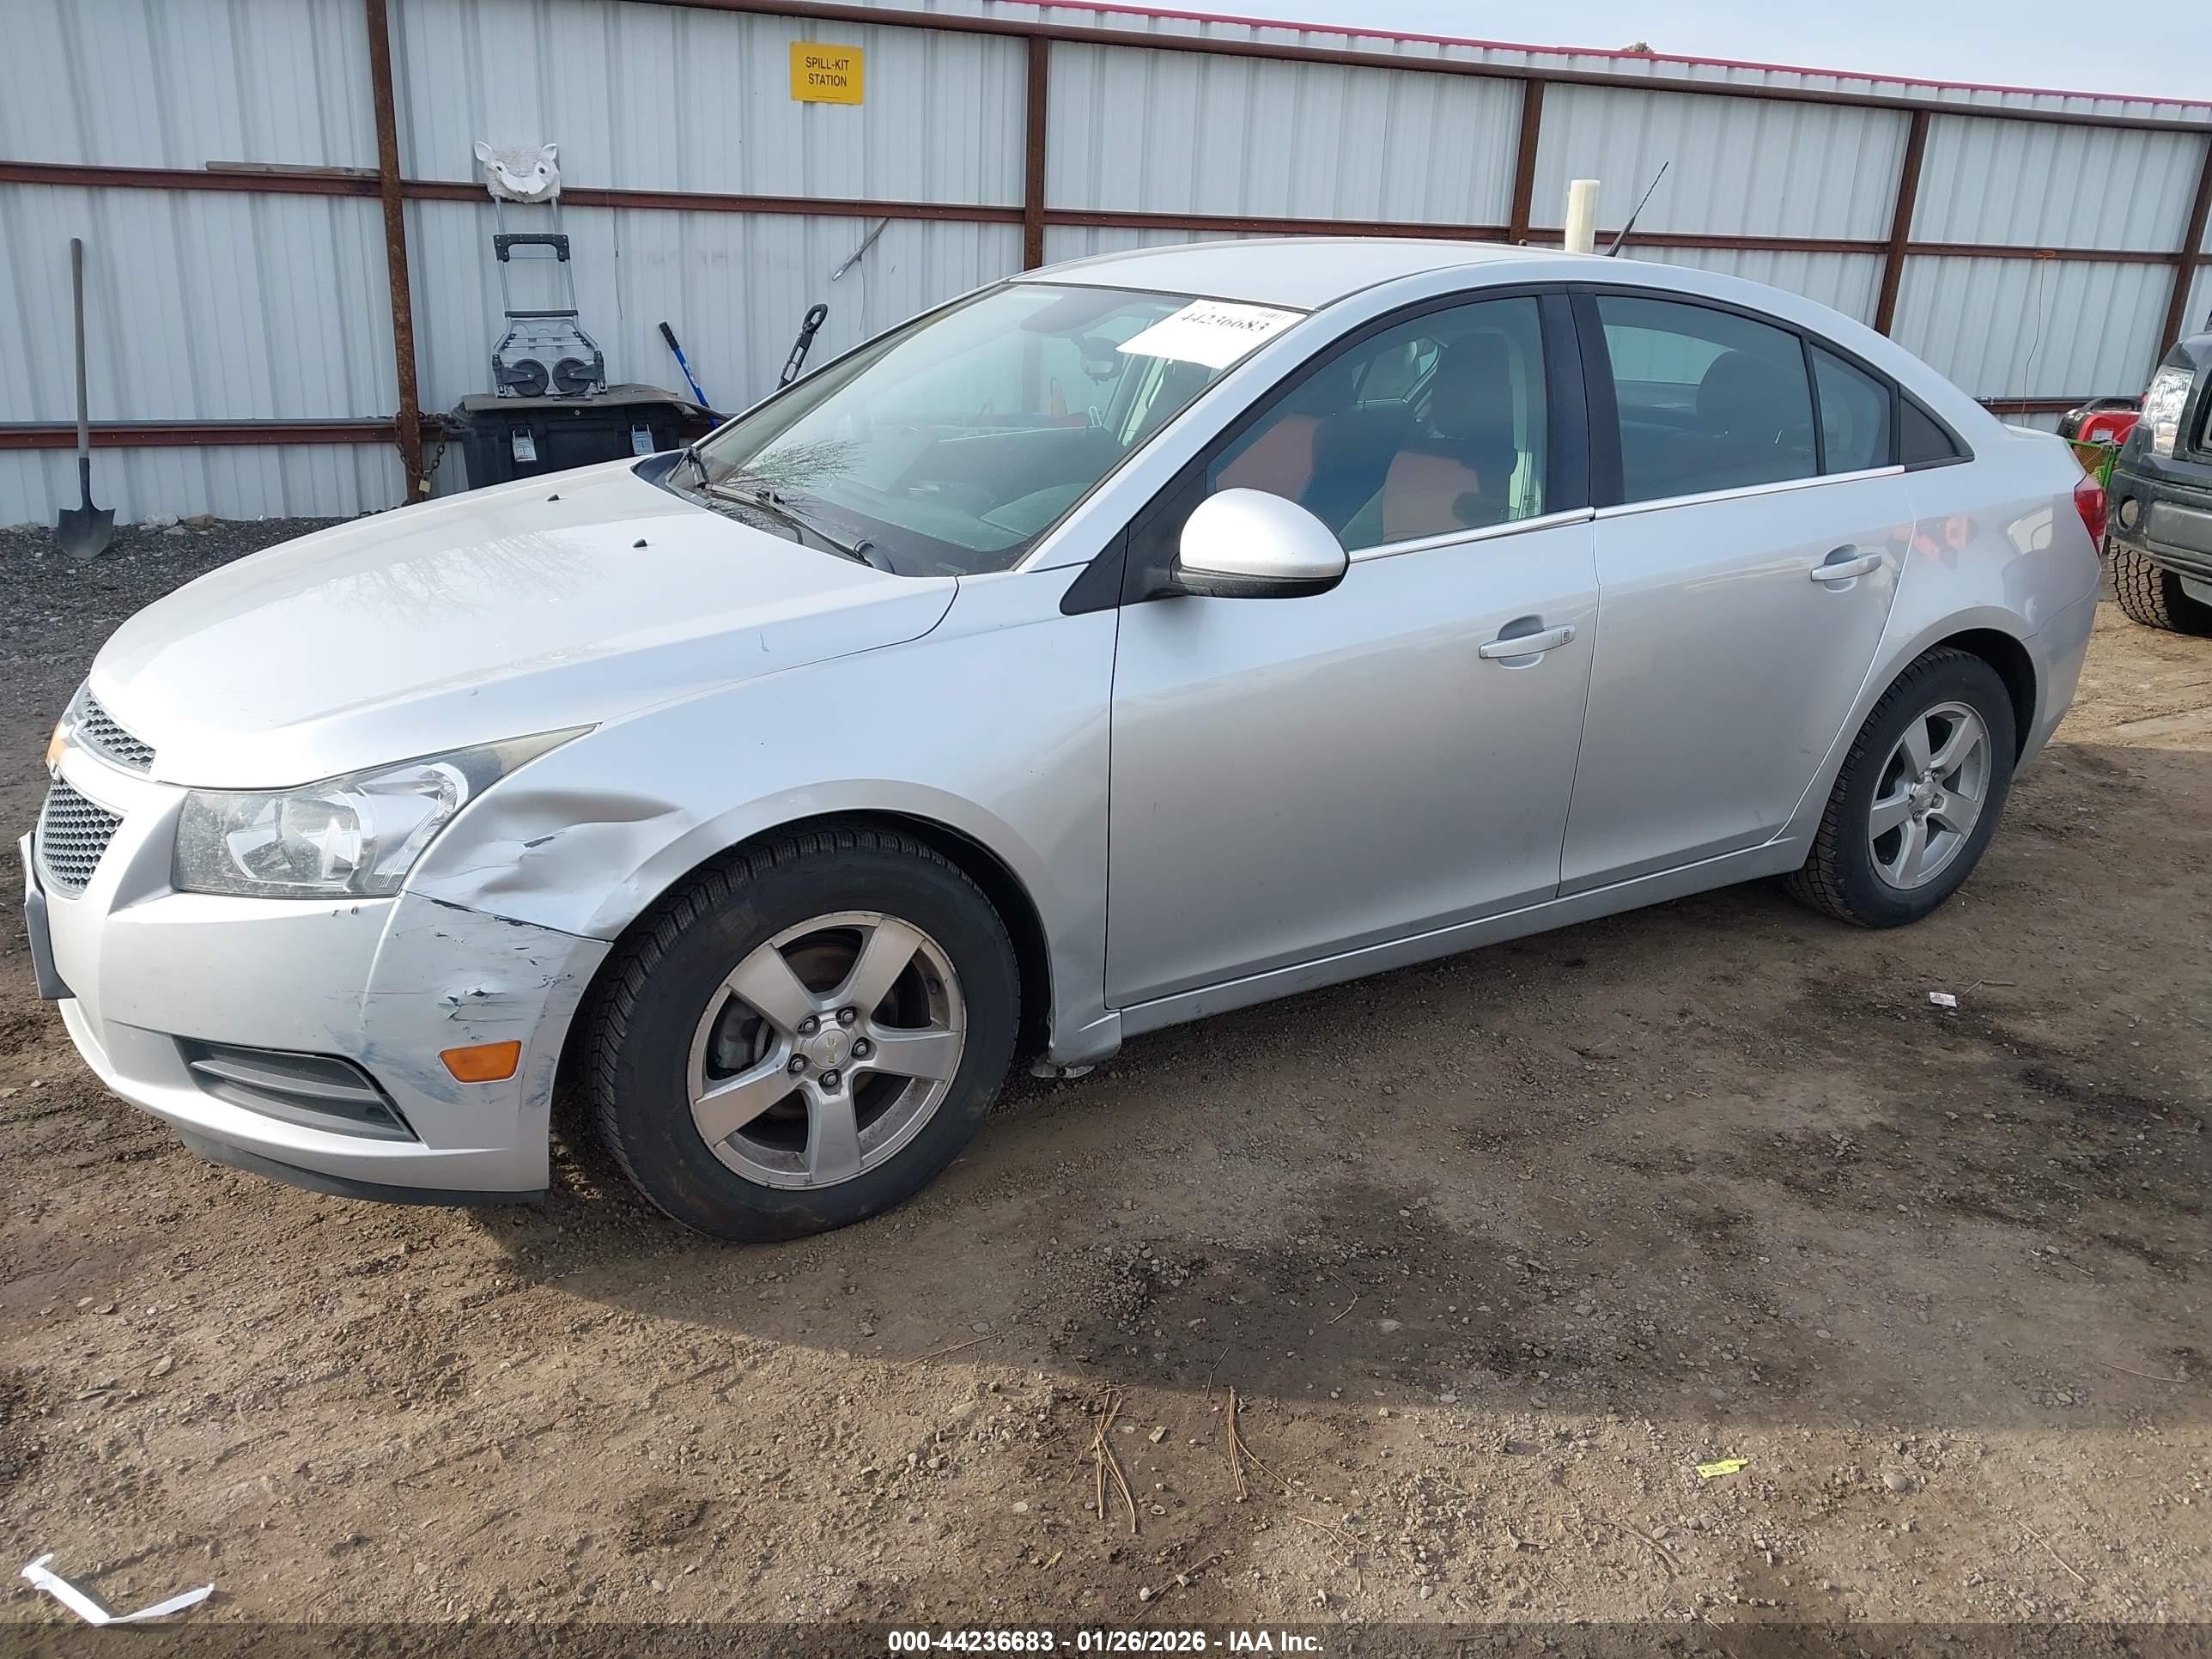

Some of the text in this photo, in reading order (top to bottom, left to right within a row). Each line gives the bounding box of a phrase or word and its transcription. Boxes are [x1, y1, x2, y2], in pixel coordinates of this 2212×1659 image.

[805, 56, 850, 71] SPILL-KIT
[808, 72, 847, 87] STATION
[1181, 313, 1270, 331] 44236683
